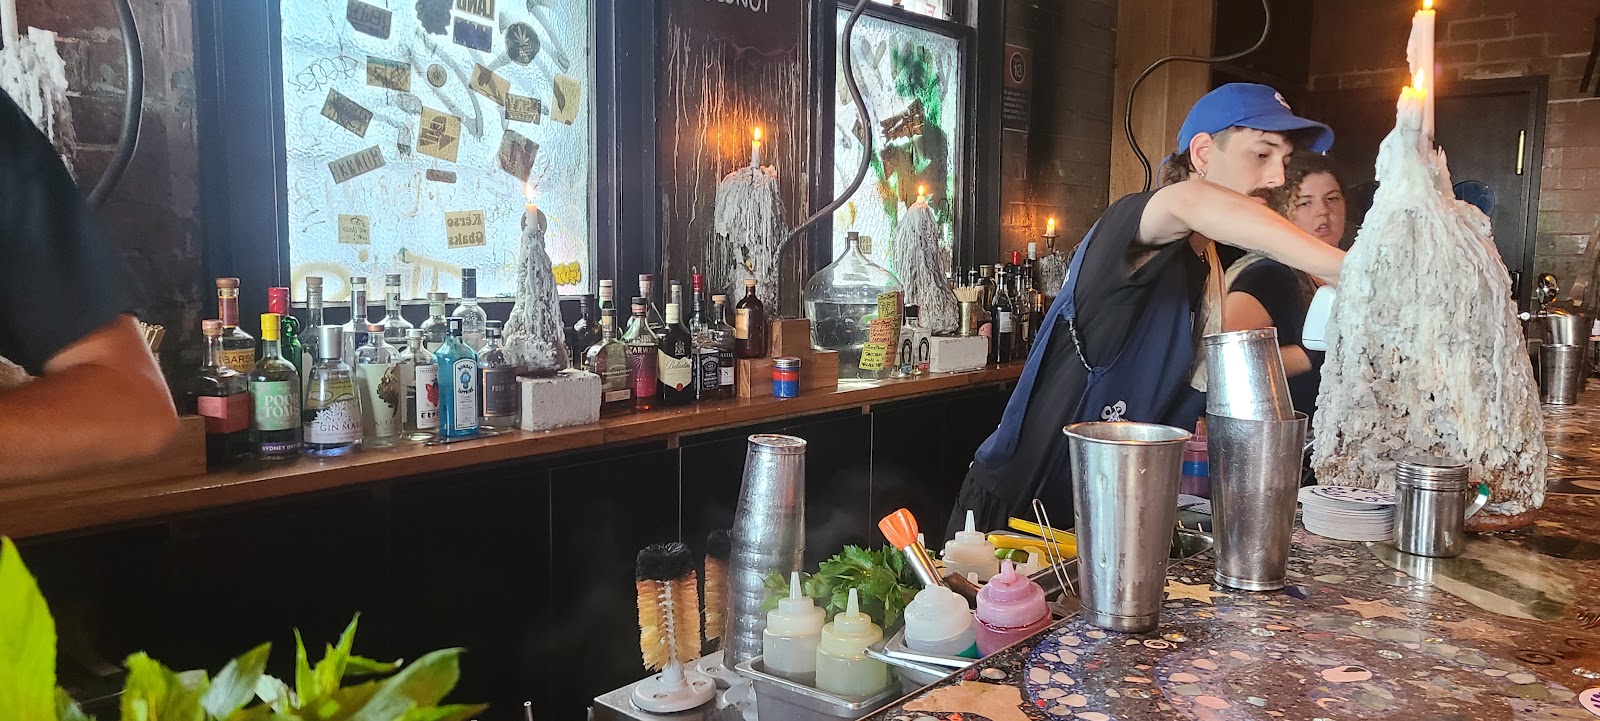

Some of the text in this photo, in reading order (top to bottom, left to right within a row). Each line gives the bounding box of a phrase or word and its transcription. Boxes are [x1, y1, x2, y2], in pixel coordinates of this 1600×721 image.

[264, 394, 299, 407] POOR
[320, 423, 338, 432] GIN
[262, 444, 286, 452] SYDNEY
